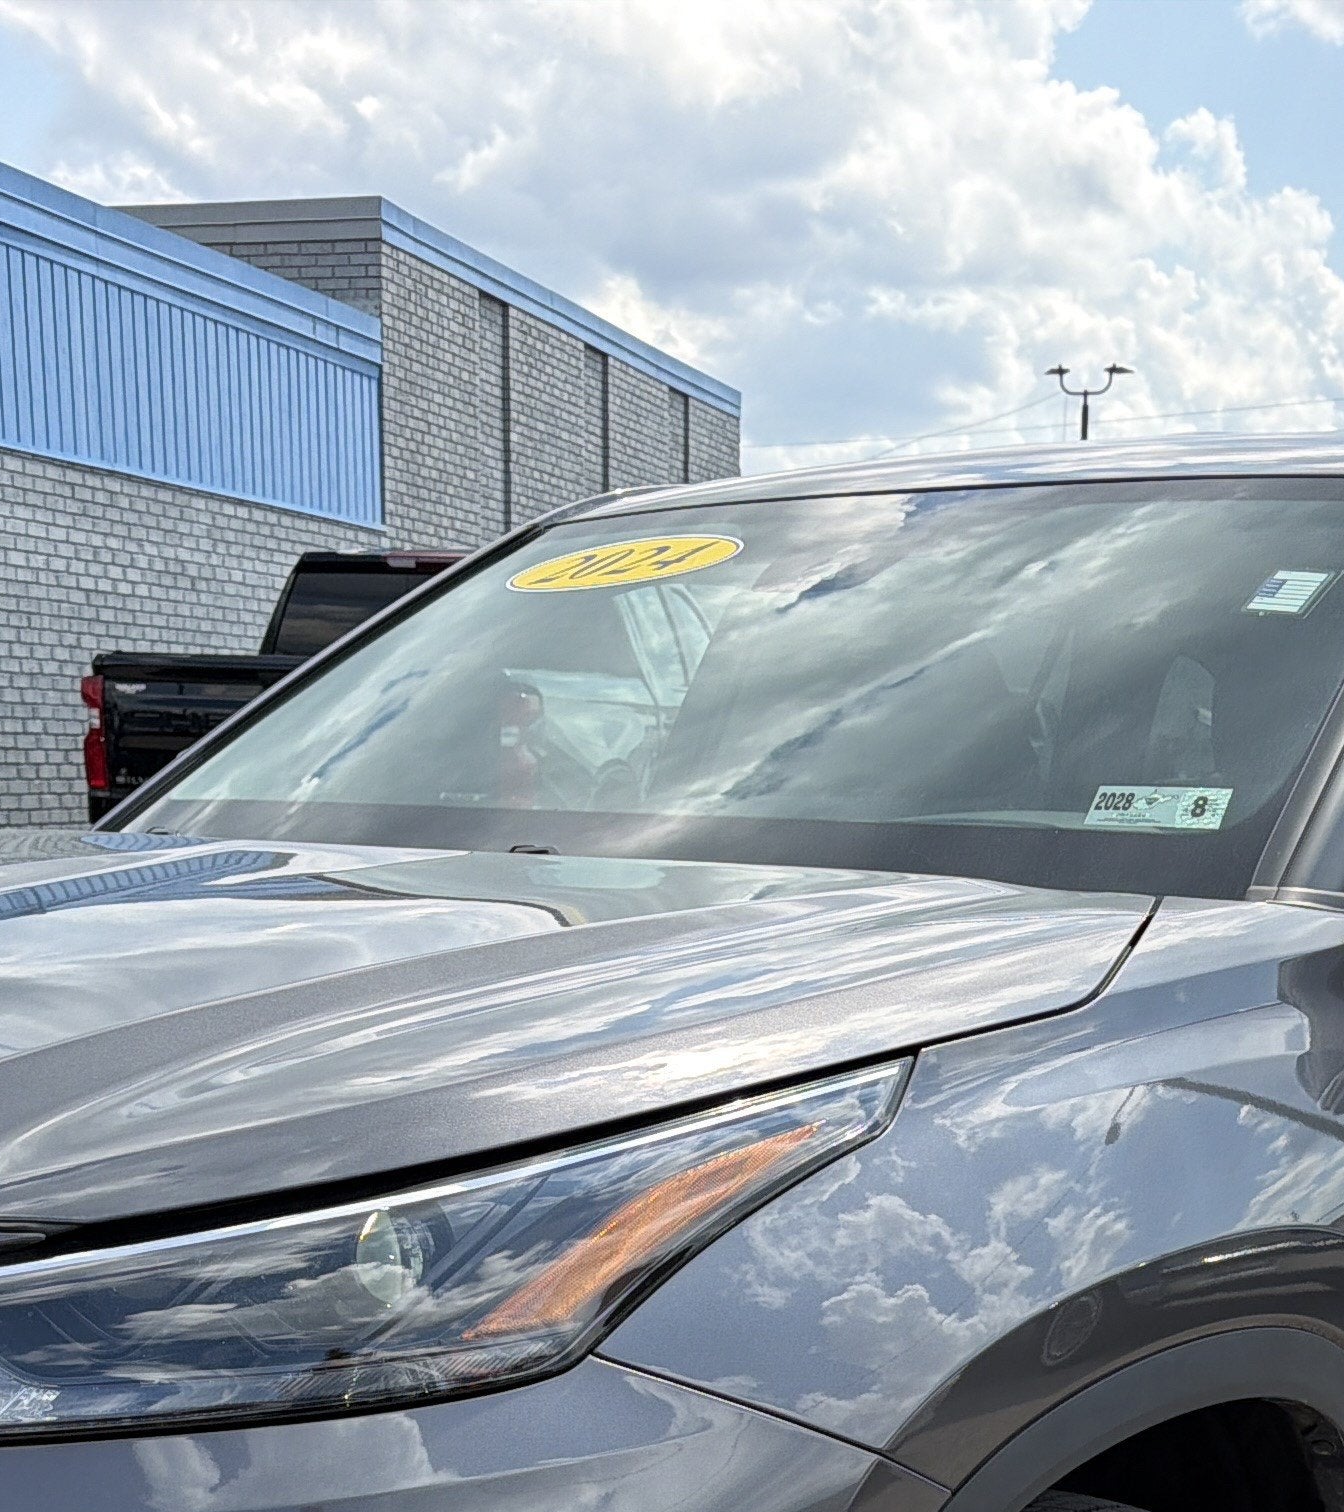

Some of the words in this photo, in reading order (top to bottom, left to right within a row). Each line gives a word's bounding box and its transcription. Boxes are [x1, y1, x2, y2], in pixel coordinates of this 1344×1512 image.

[526, 540, 720, 586] 2024
[1093, 792, 1136, 811] 2028
[1190, 795, 1209, 818] 8
